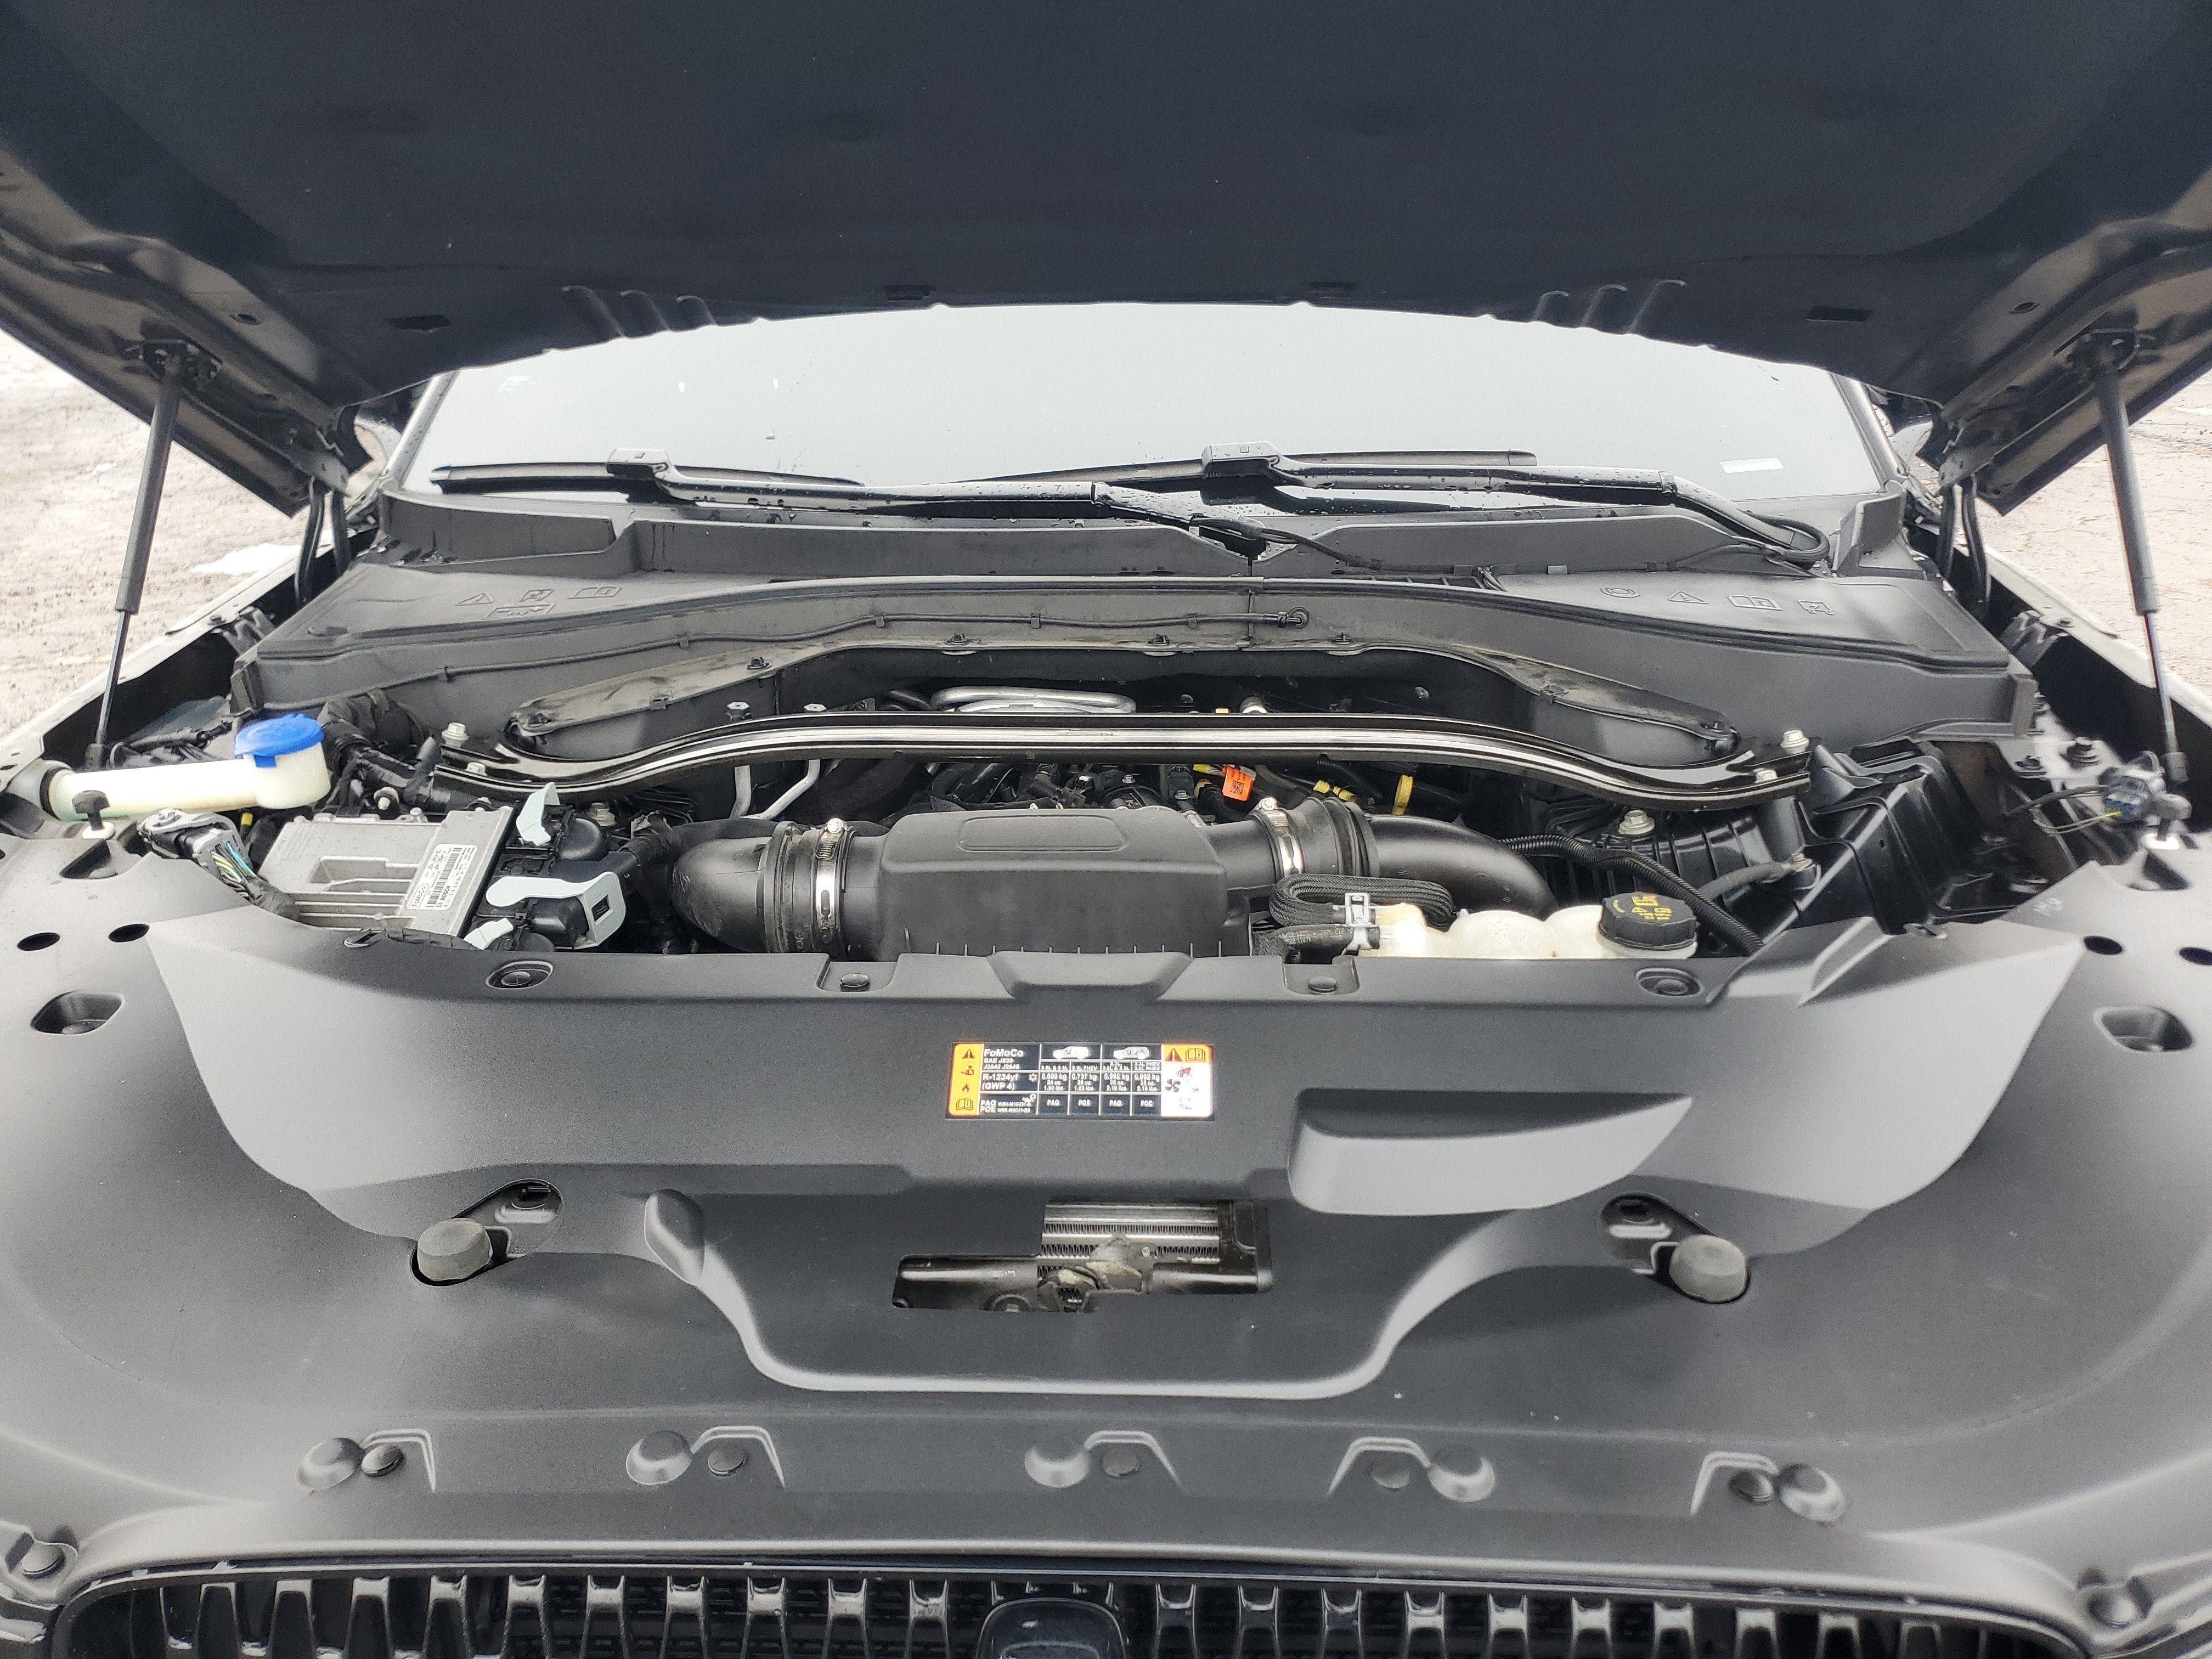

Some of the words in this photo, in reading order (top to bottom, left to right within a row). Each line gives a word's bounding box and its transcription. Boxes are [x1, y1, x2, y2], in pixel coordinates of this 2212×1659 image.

[440, 885, 451, 900] BOSCH
[984, 1048, 1024, 1057] FoMoCo
[983, 1073, 1018, 1082] R-1234yf
[1059, 1073, 1067, 1081] kg
[1089, 1073, 1097, 1081] kg
[1121, 1073, 1130, 1082] kg
[1152, 1074, 1160, 1082] kg
[982, 1082, 1006, 1091] (GWP
[1006, 1082, 1015, 1091] 4)
